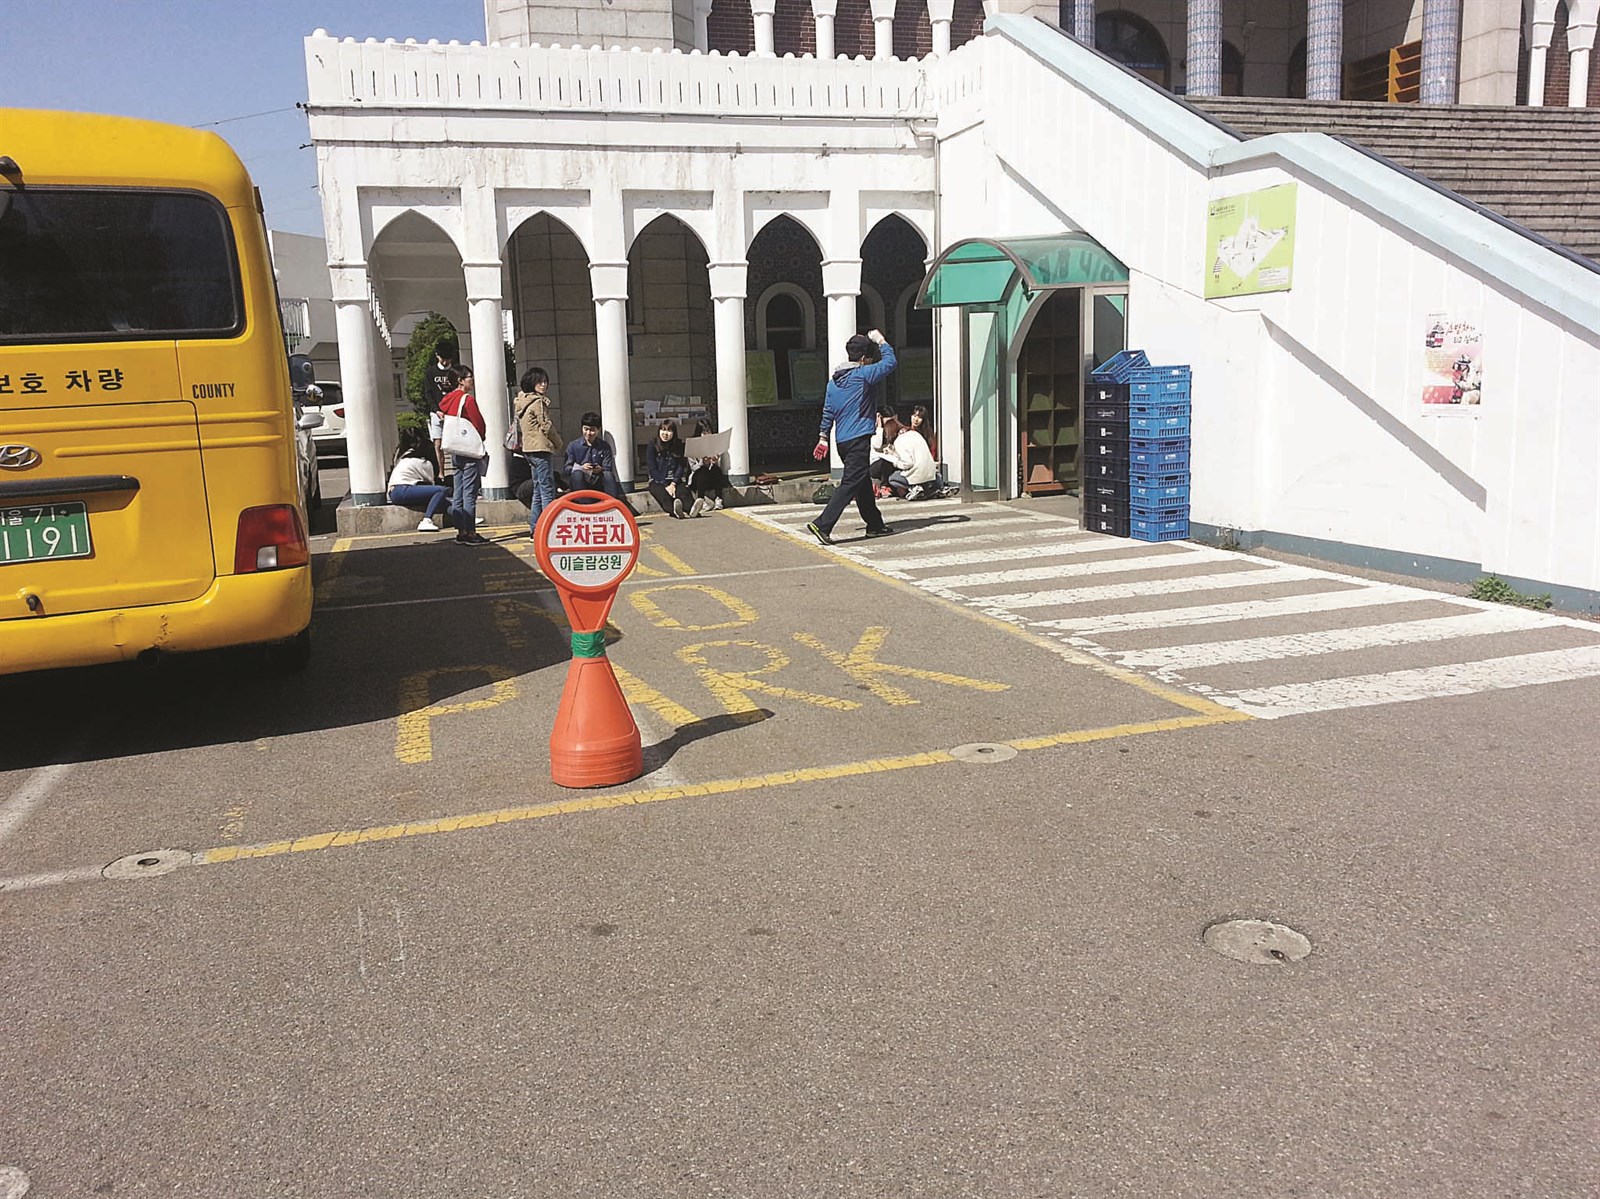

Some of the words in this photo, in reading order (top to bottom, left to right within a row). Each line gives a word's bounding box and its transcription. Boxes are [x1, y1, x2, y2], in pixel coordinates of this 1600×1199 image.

[65, 368, 125, 392] 차량
[192, 383, 235, 399] COUNTY
[29, 507, 55, 523] 71
[3, 524, 78, 560] 1191
[556, 523, 625, 545] 주차금지
[560, 554, 622, 571] 이슬람성원
